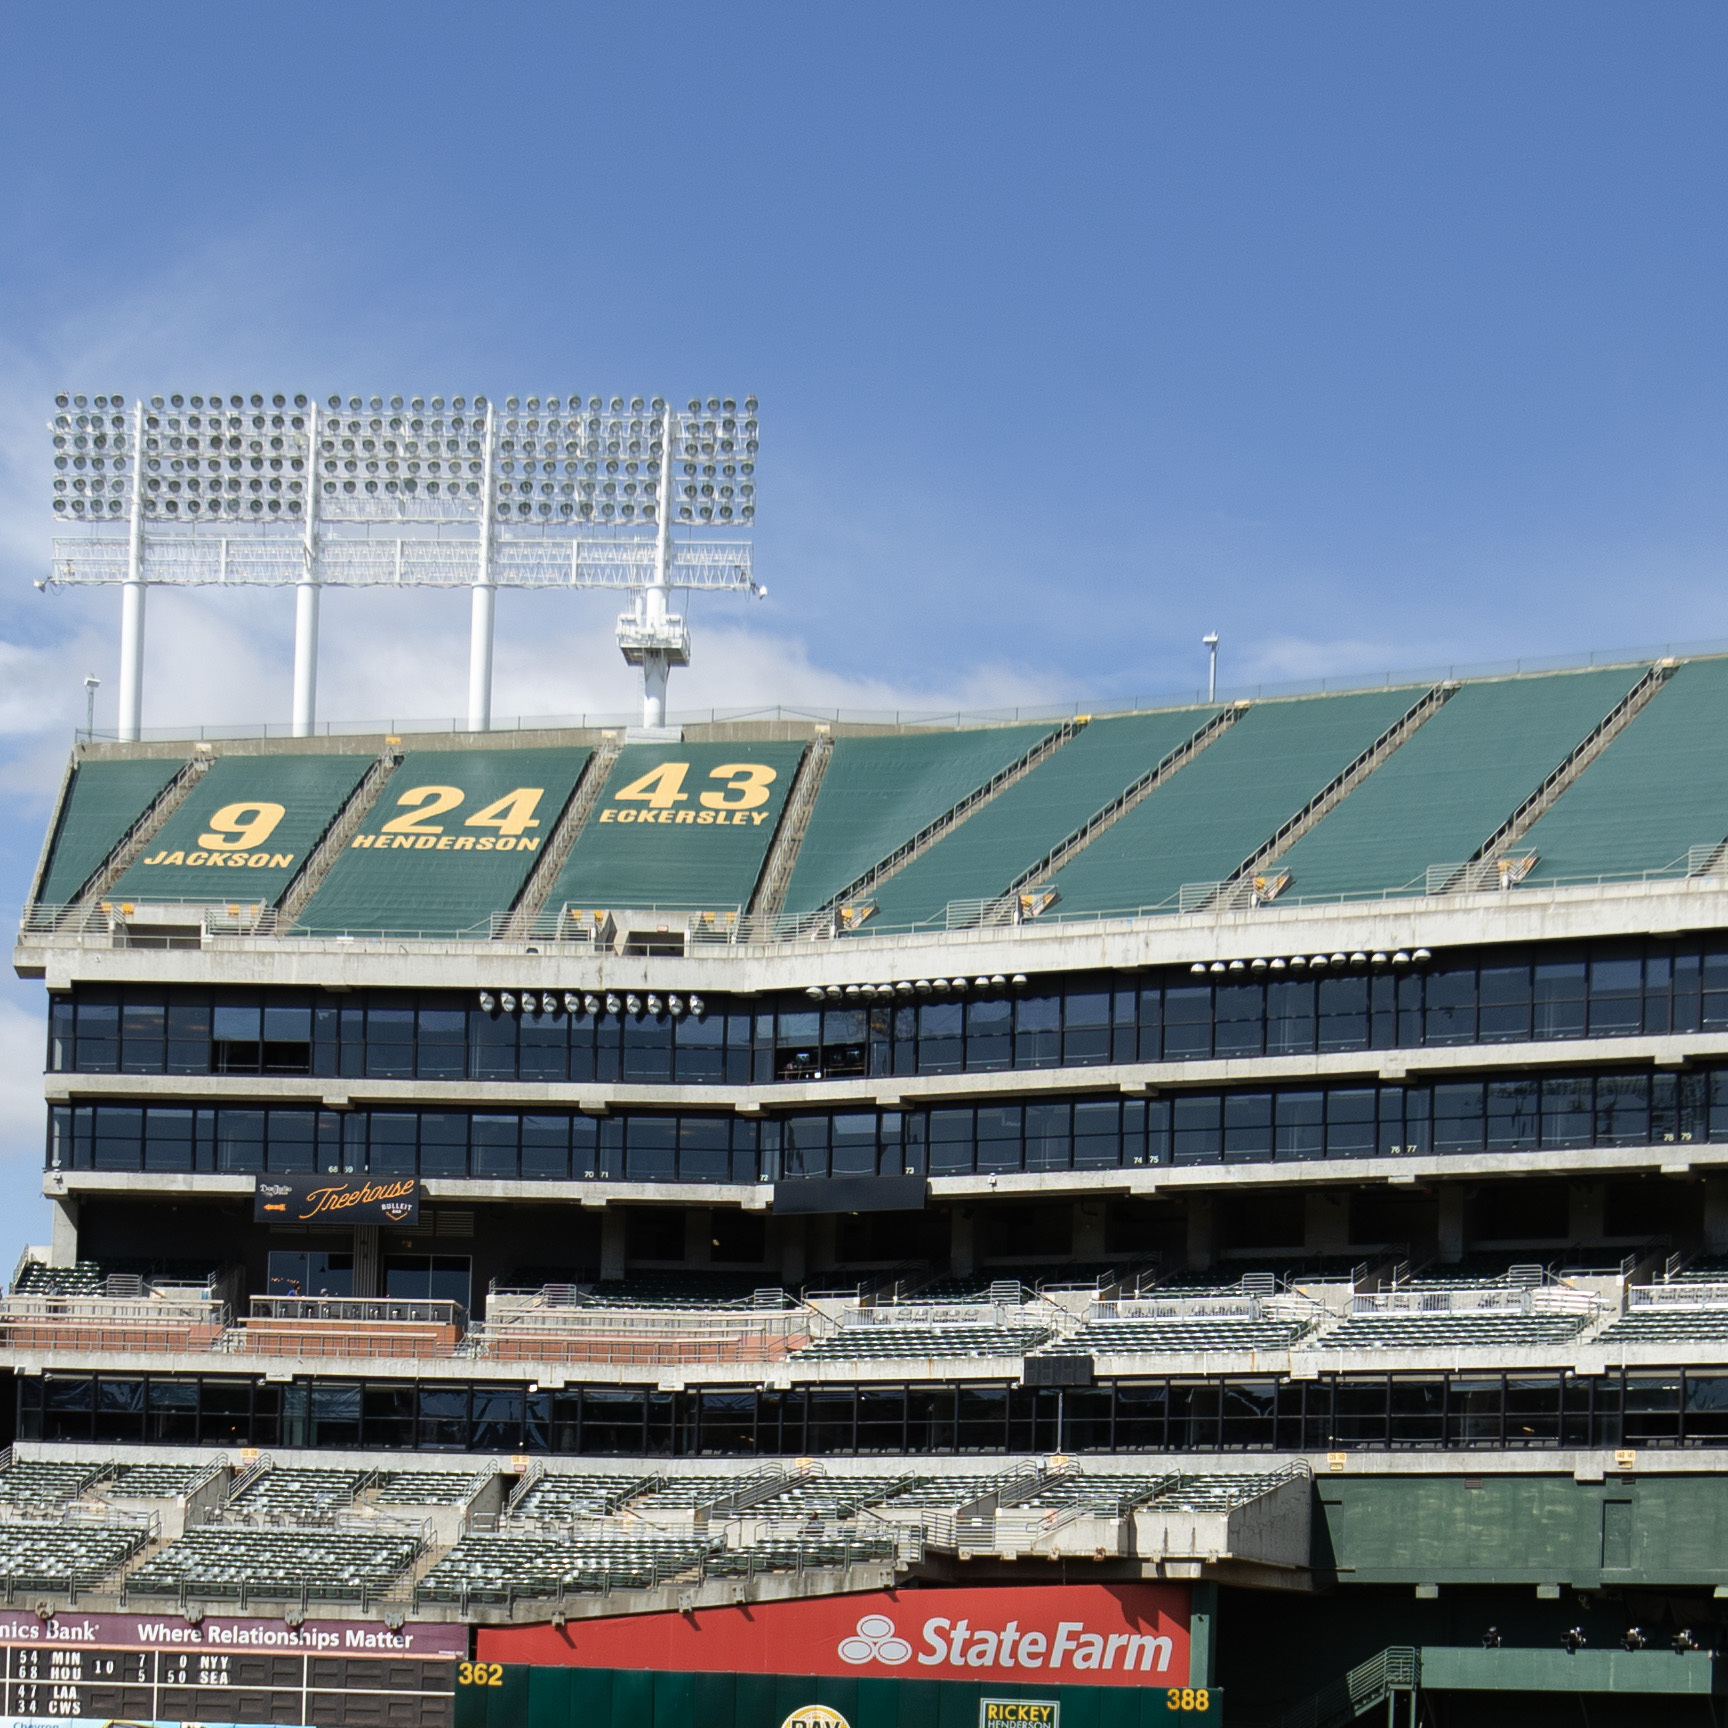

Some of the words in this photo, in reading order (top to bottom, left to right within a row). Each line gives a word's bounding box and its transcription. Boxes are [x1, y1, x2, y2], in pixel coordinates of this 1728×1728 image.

[614, 762, 777, 810] 43
[381, 785, 544, 835] 24
[599, 808, 769, 826] ECKERSLEY
[197, 802, 286, 850] 9
[351, 834, 540, 851] HENDERSON
[143, 851, 294, 868] JACKSON
[299, 1179, 414, 1219] Treehouse
[46, 1620, 96, 1641] Bank
[137, 1623, 202, 1643] Where
[208, 1625, 340, 1650] Relationships
[346, 1630, 413, 1649] Matter
[19, 1650, 38, 1664] 54
[52, 1651, 81, 1665] MIN
[138, 1654, 146, 1667] 7
[95, 1660, 114, 1674] 10
[179, 1655, 188, 1669] 0
[200, 1656, 229, 1670] NYY
[19, 1666, 38, 1679] 68
[51, 1667, 82, 1680] HOU
[138, 1669, 146, 1682] 5
[168, 1670, 186, 1684] 50
[200, 1671, 229, 1685] SEA
[458, 1662, 503, 1686] 362
[18, 1684, 37, 1698] 47
[53, 1685, 77, 1700] LAA
[1166, 1688, 1210, 1712] 388
[18, 1701, 37, 1714] 34
[48, 1701, 81, 1715] CWS
[987, 1703, 1051, 1721] RICKEY
